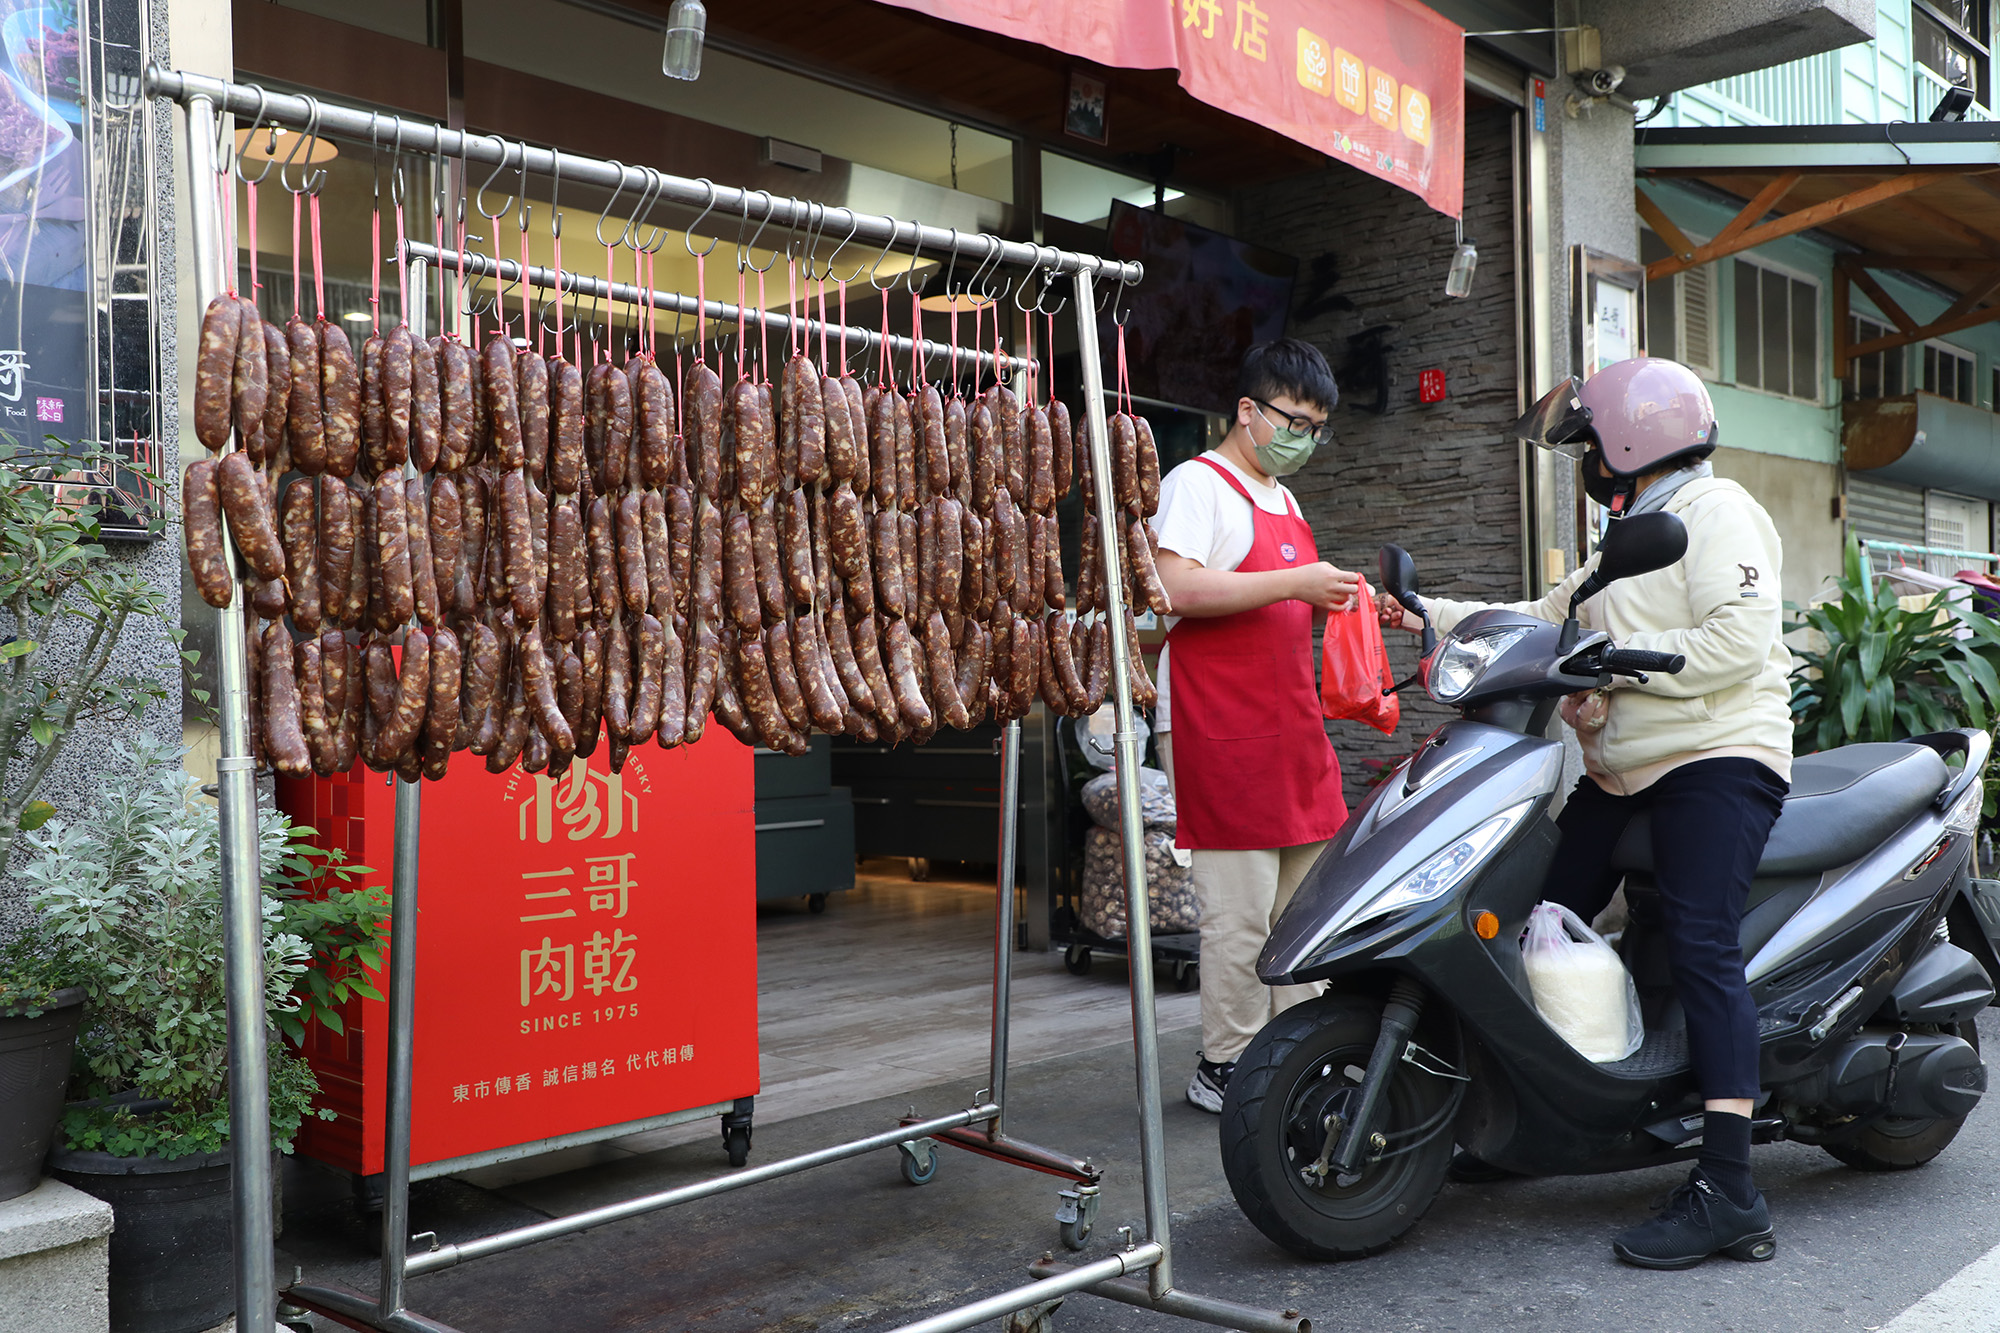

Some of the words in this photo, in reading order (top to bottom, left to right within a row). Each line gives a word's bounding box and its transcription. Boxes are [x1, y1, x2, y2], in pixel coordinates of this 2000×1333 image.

[1182, 0, 1269, 63] 好店
[1737, 563, 1759, 588] P
[519, 852, 639, 923] 三哥
[519, 928, 639, 1007] 肉乾
[520, 1011, 583, 1034] SINCE
[592, 1003, 639, 1023] 1975
[452, 1072, 532, 1103] 東市傳香
[542, 1058, 616, 1087] 誠信揚名
[625, 1044, 695, 1072] 代代相傳
